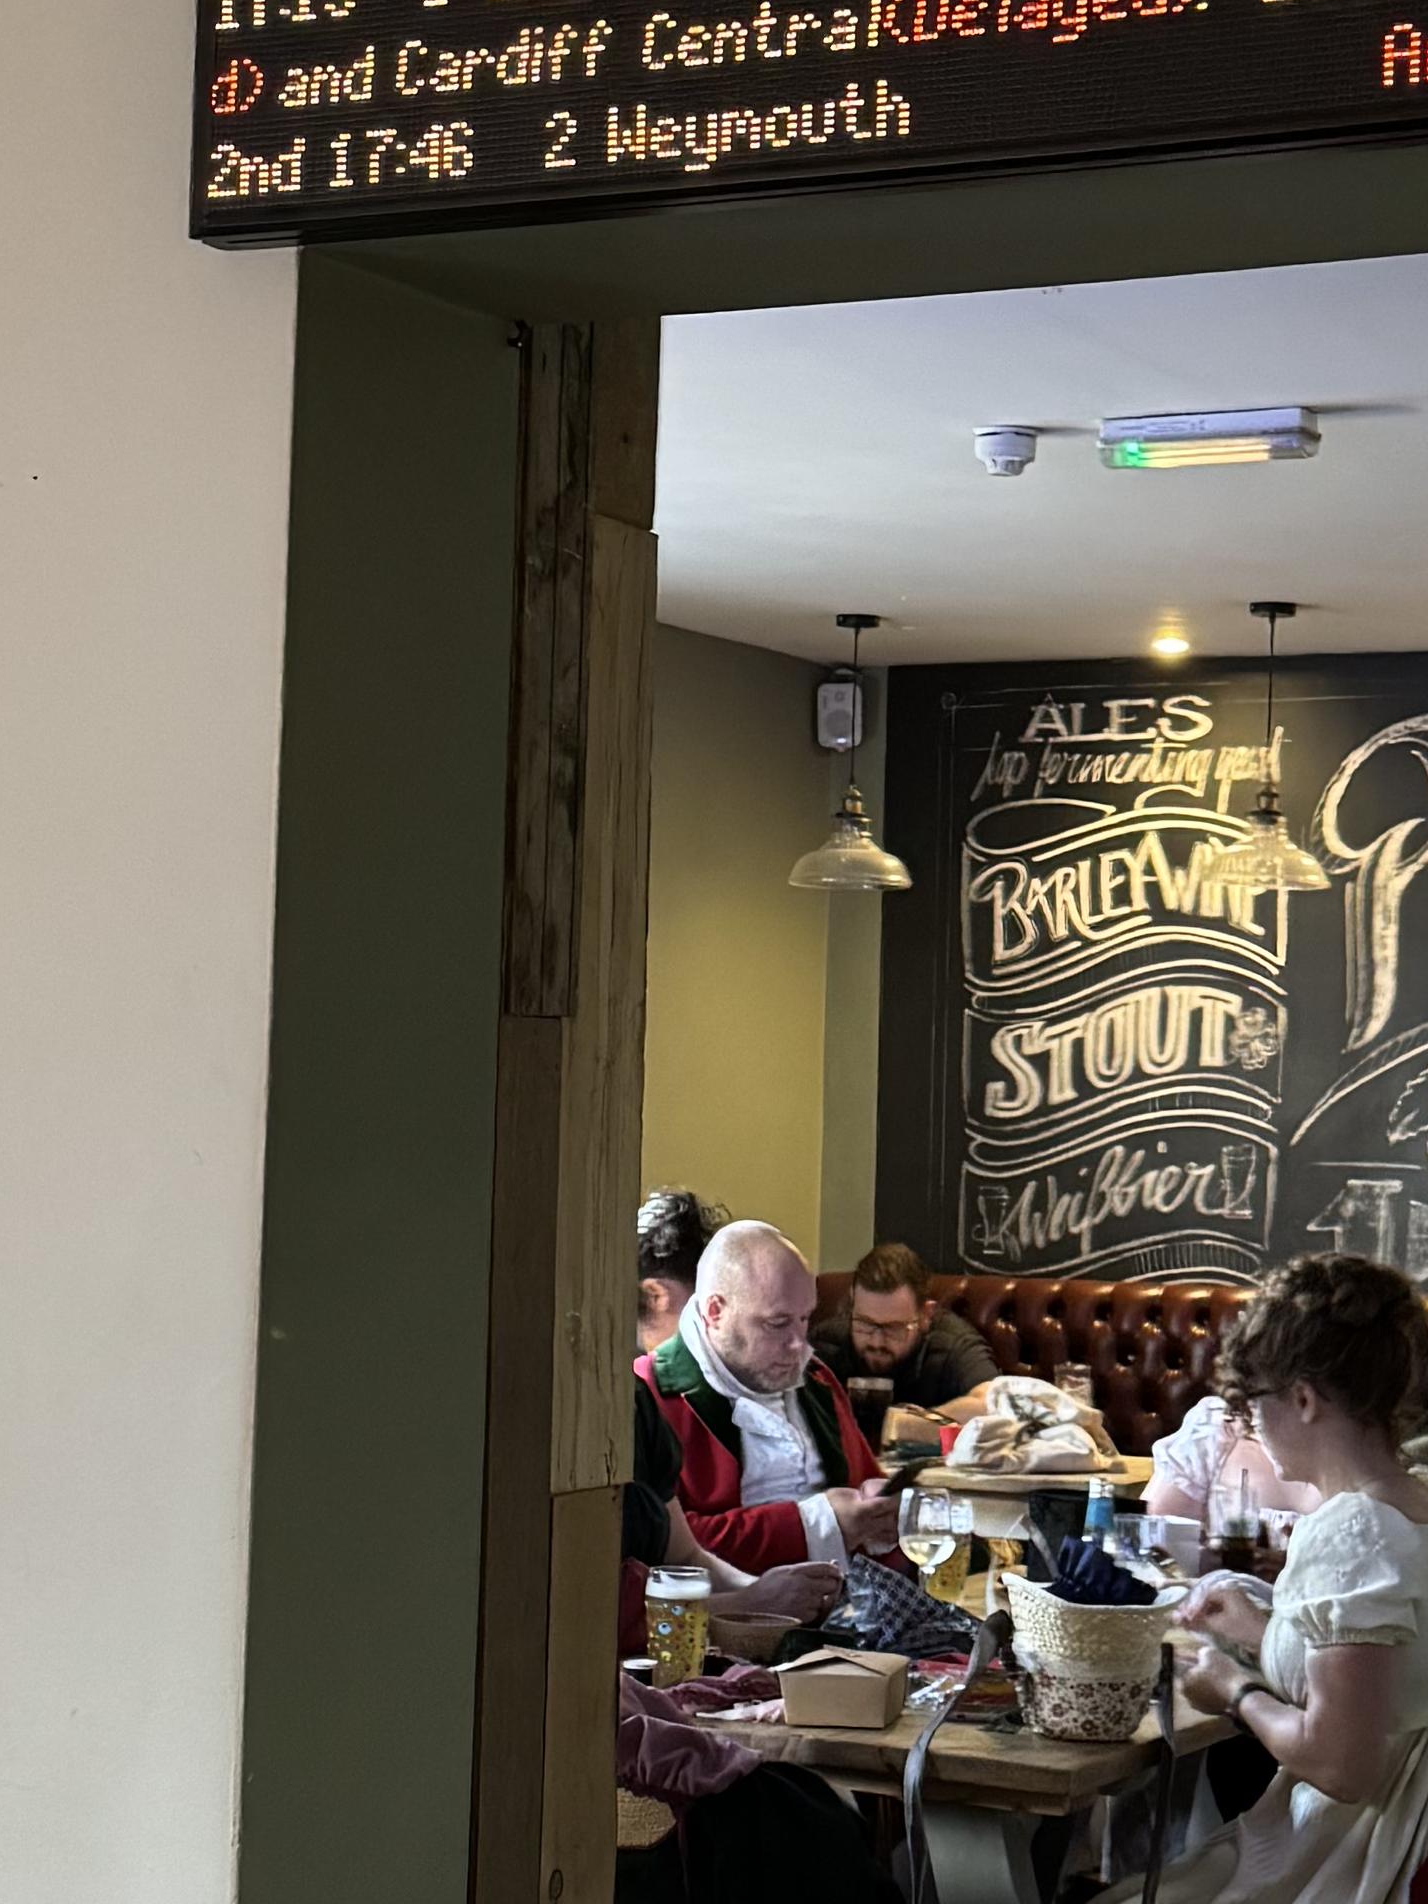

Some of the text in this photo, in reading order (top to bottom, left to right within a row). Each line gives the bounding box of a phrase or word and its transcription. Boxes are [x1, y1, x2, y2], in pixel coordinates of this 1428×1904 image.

[278, 45, 374, 106] and
[395, 19, 613, 97] Cardiff
[208, 138, 307, 199] 2nd
[329, 121, 474, 188] 17:46
[545, 111, 577, 169] 2
[607, 78, 911, 172] Weymouth
[1018, 693, 1214, 743] ALES
[1033, 735, 1214, 800] fermenting
[984, 984, 1243, 1119] STOUT
